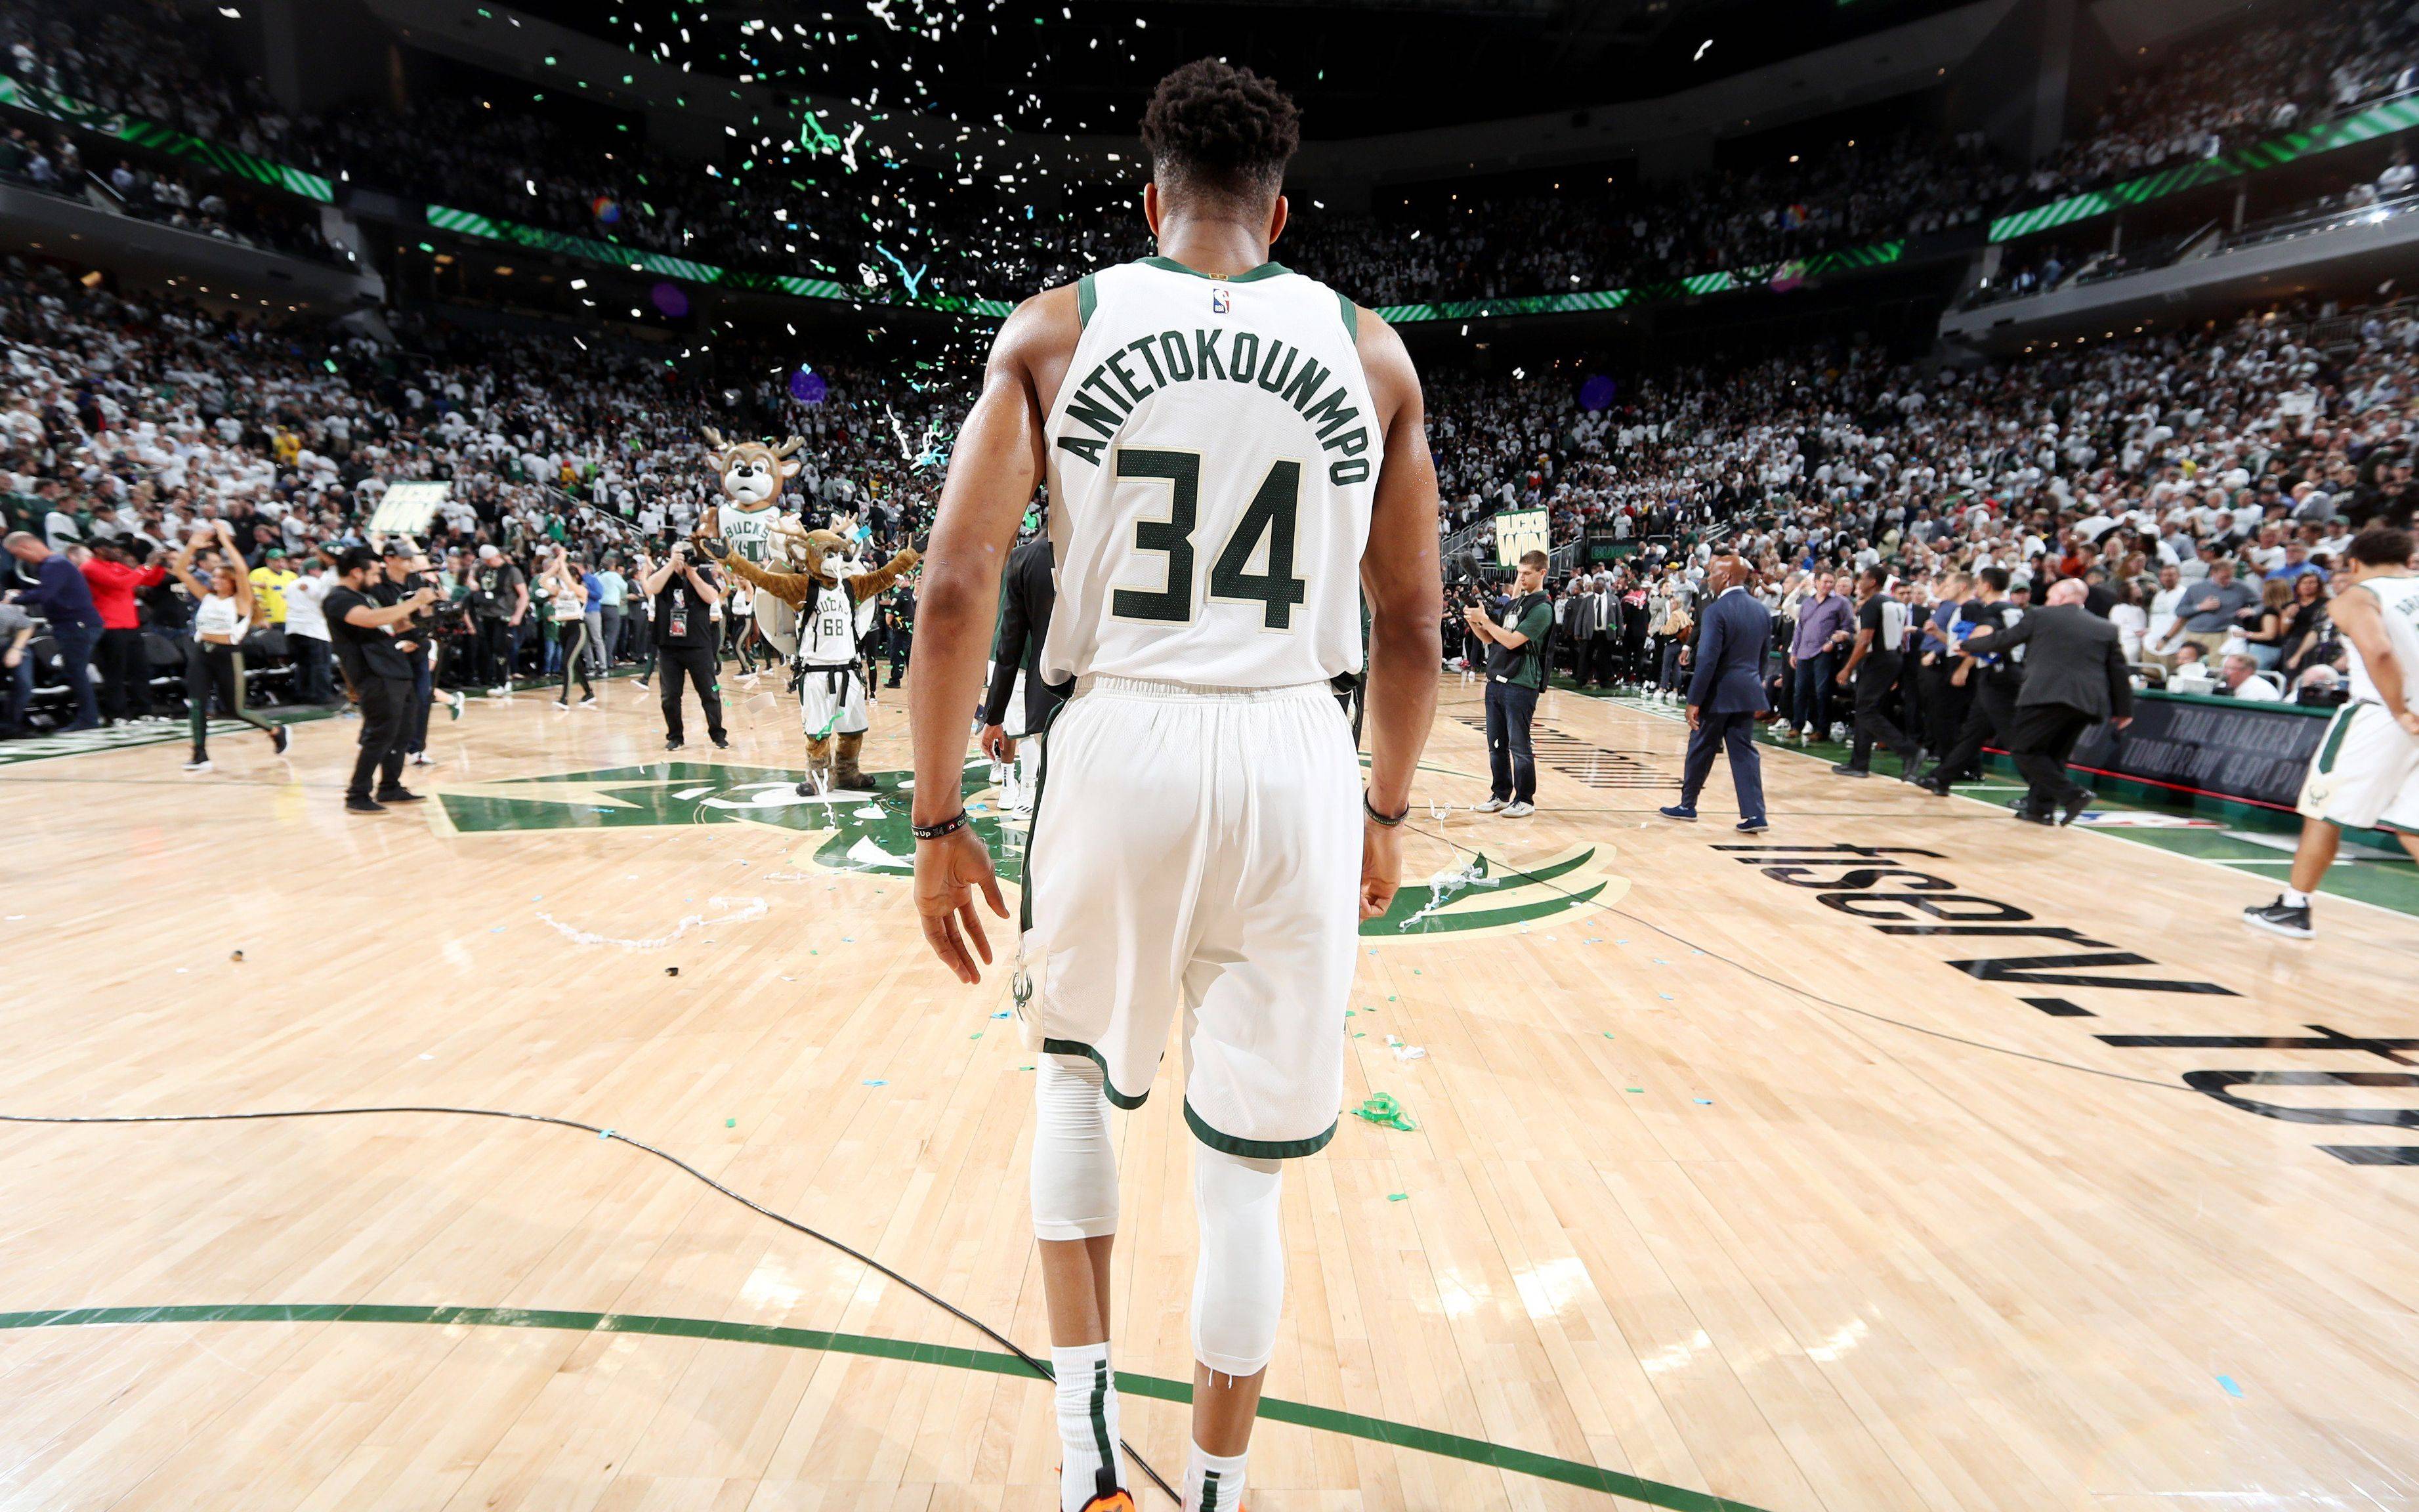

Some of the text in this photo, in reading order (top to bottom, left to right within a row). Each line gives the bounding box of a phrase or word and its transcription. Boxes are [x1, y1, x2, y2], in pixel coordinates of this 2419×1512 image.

[1057, 329, 1370, 486] ANTETOKOUNMPO
[725, 521, 770, 539] BUCKS
[1110, 446, 1309, 632] 34
[1496, 511, 1547, 536] BUCKS
[1498, 532, 1547, 567] WIN
[824, 619, 843, 635] 68
[2214, 713, 2304, 755] BLAZERS
[2120, 737, 2223, 780] TOMORROW
[1709, 843, 2241, 1017] fiserv.
